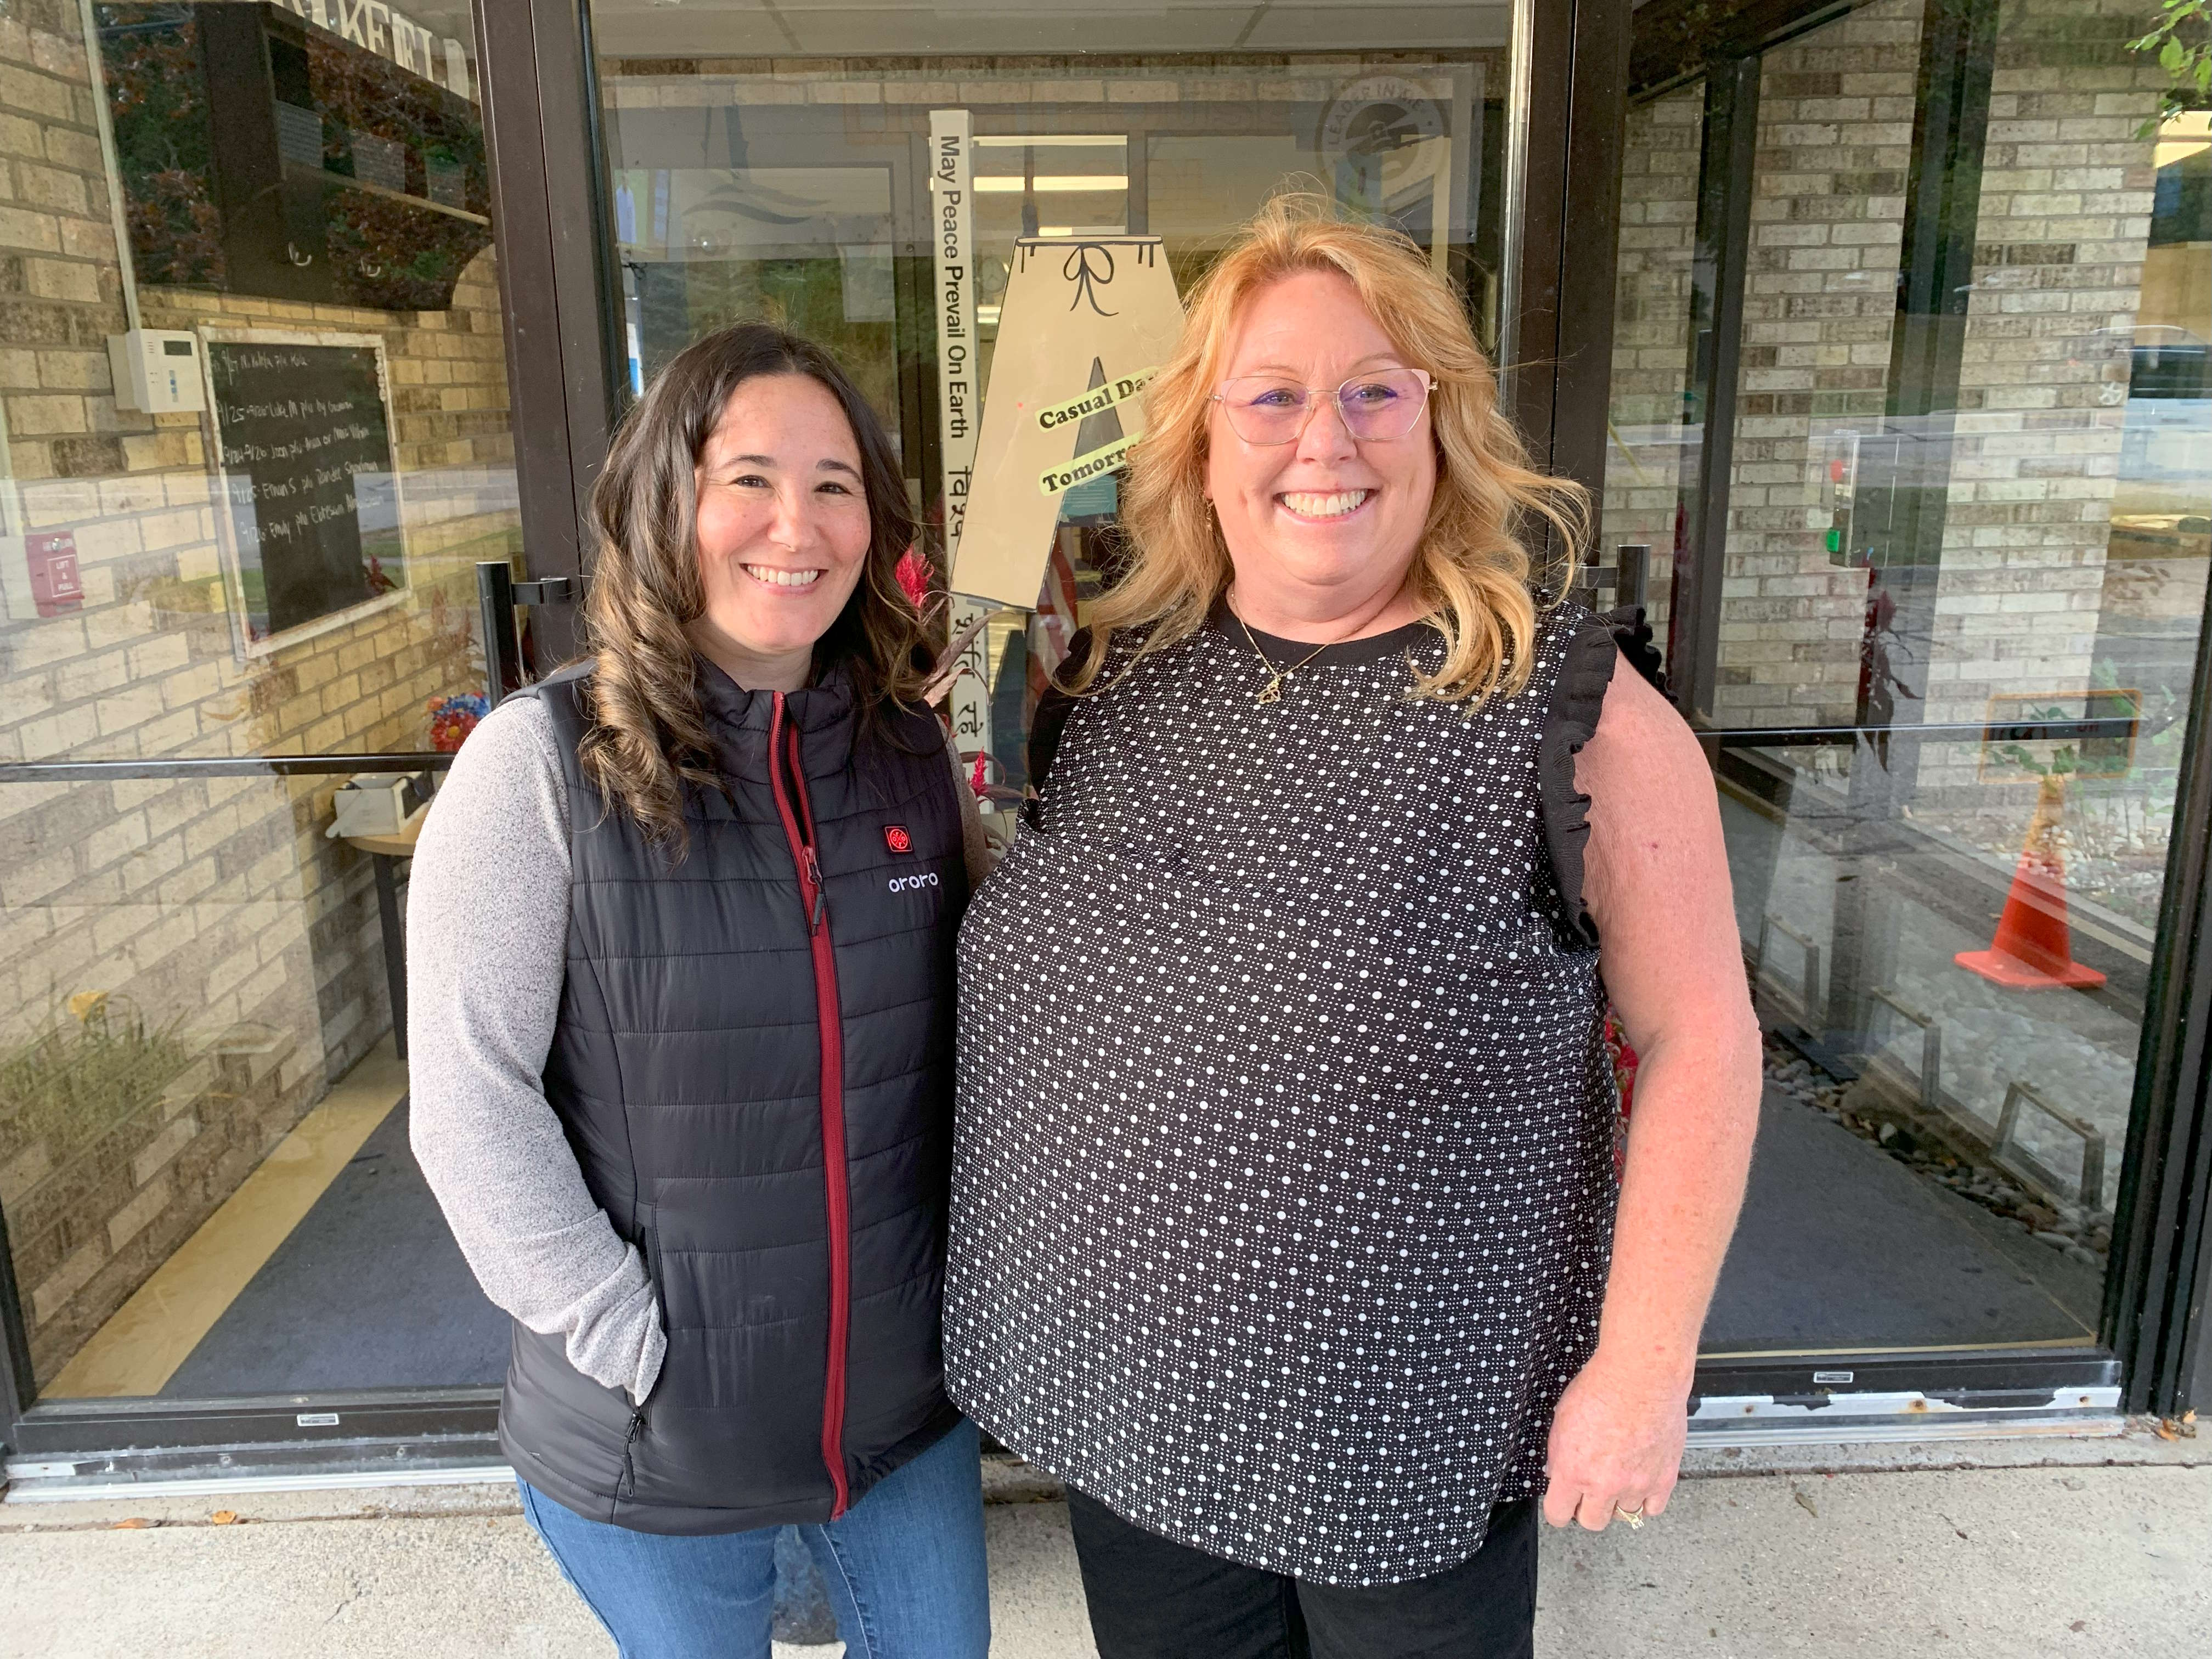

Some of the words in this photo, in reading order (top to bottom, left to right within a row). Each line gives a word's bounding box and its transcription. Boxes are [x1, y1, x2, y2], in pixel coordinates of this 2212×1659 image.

[938, 136, 960, 183] May
[943, 190, 961, 259] Peace
[945, 266, 966, 338] Prevail
[948, 345, 966, 375] On
[949, 381, 969, 439] Earth
[1040, 387, 1114, 429] Casual
[1114, 372, 1159, 399] Da
[888, 872, 939, 893] ororo
